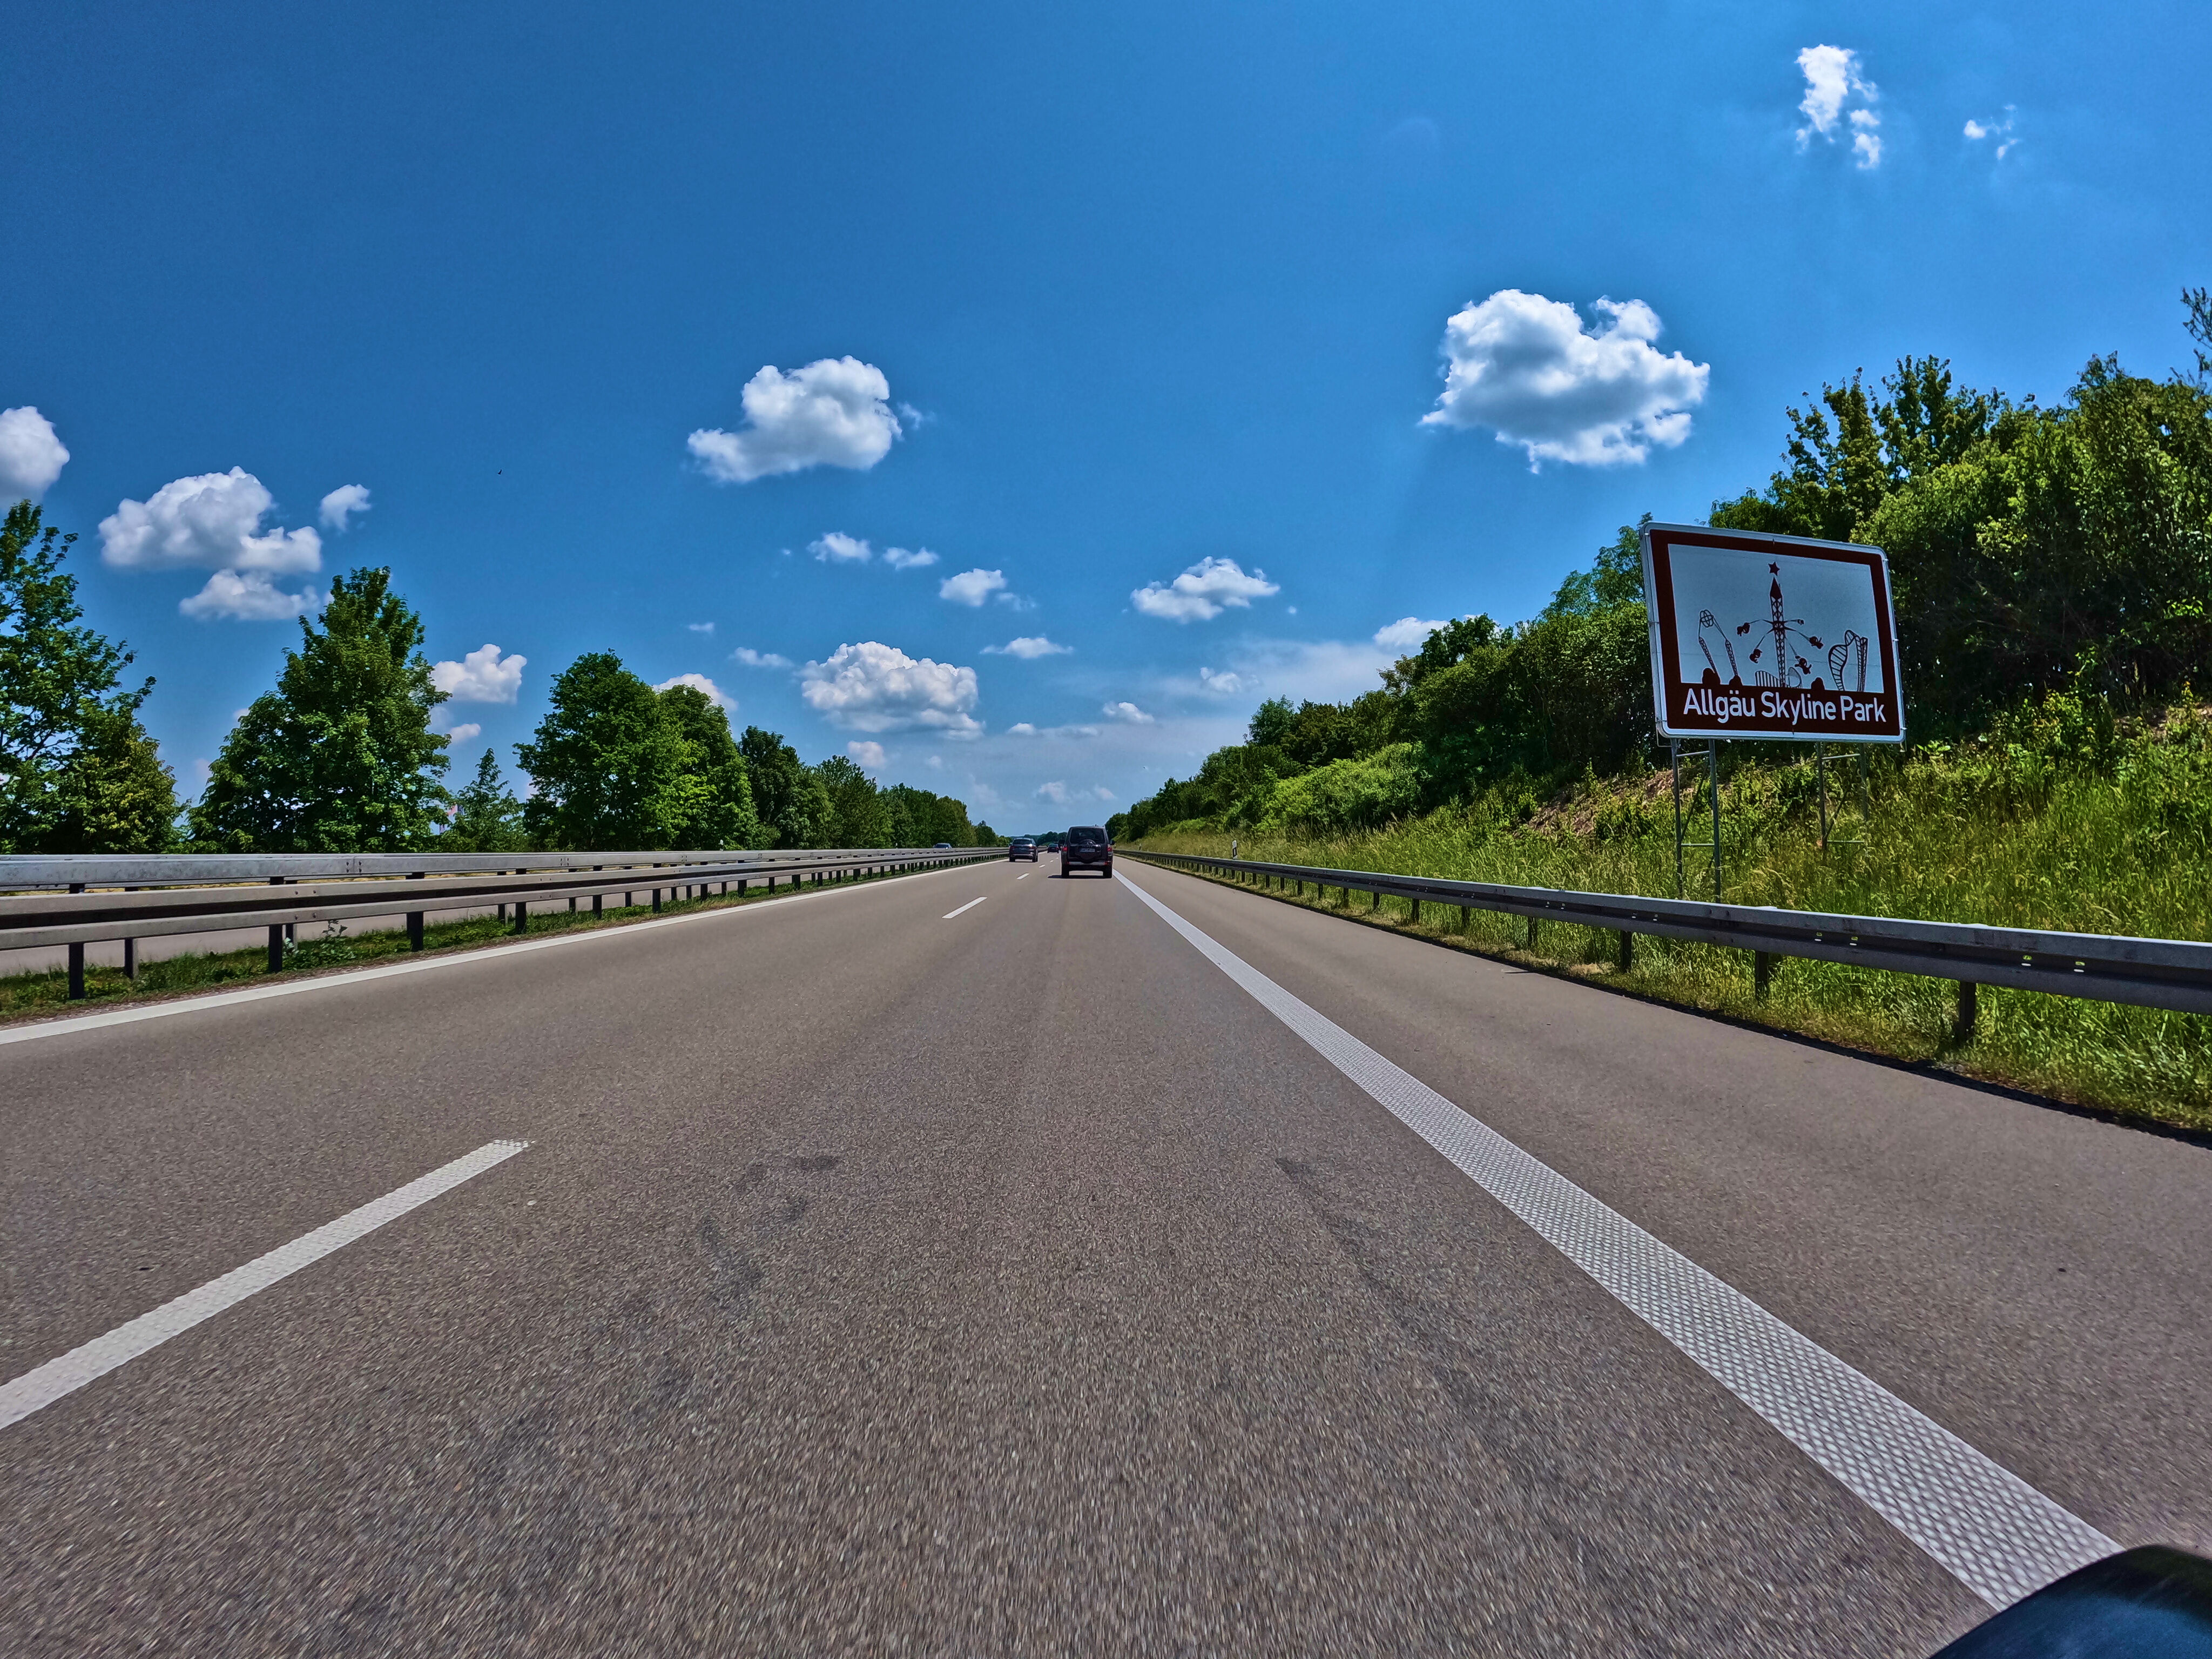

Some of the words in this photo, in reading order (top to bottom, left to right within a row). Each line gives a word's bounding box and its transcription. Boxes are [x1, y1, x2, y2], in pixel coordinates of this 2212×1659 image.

[1683, 688, 1756, 724] Allgäu
[1761, 691, 1836, 725] Skyline
[1840, 696, 1886, 723] Park
